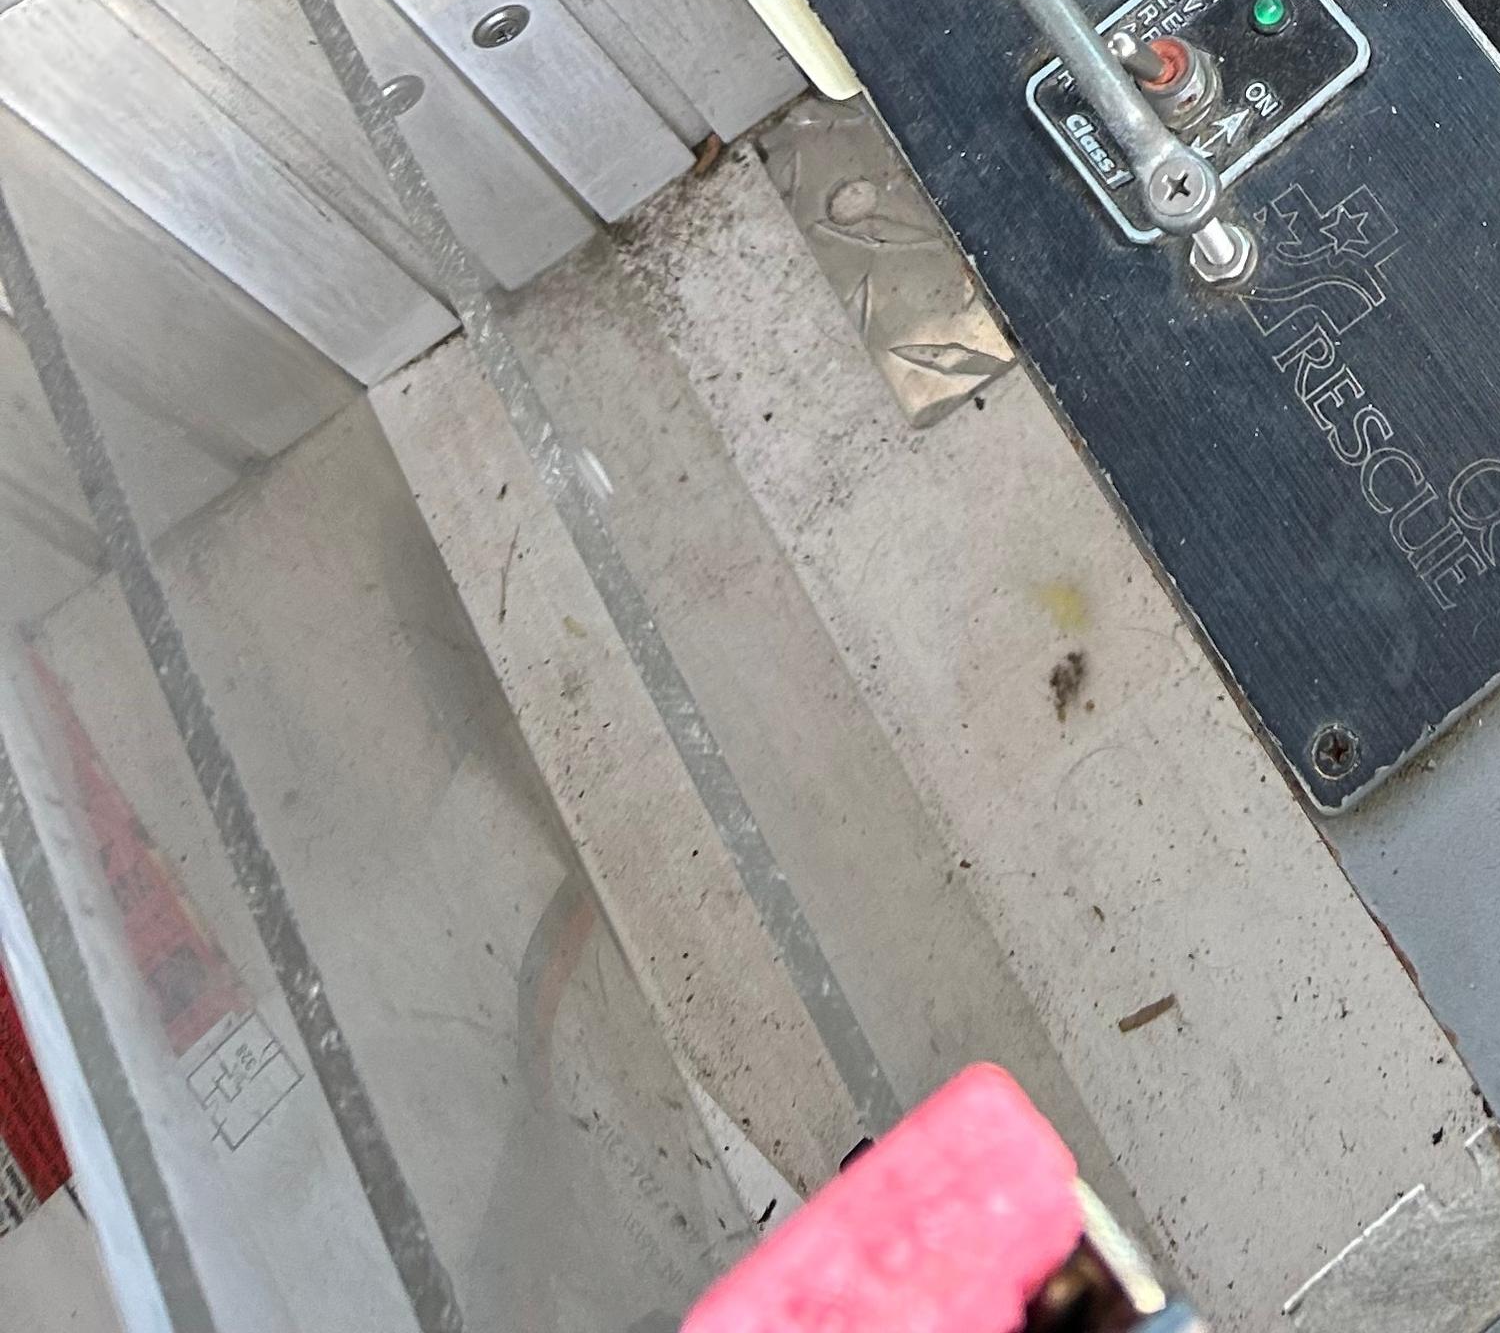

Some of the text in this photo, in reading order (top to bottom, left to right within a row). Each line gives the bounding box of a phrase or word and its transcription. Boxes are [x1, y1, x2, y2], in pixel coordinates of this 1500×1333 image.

[1241, 80, 1279, 117] ON
[1063, 110, 1119, 174] Class
[1272, 324, 1487, 611] RESCUE
